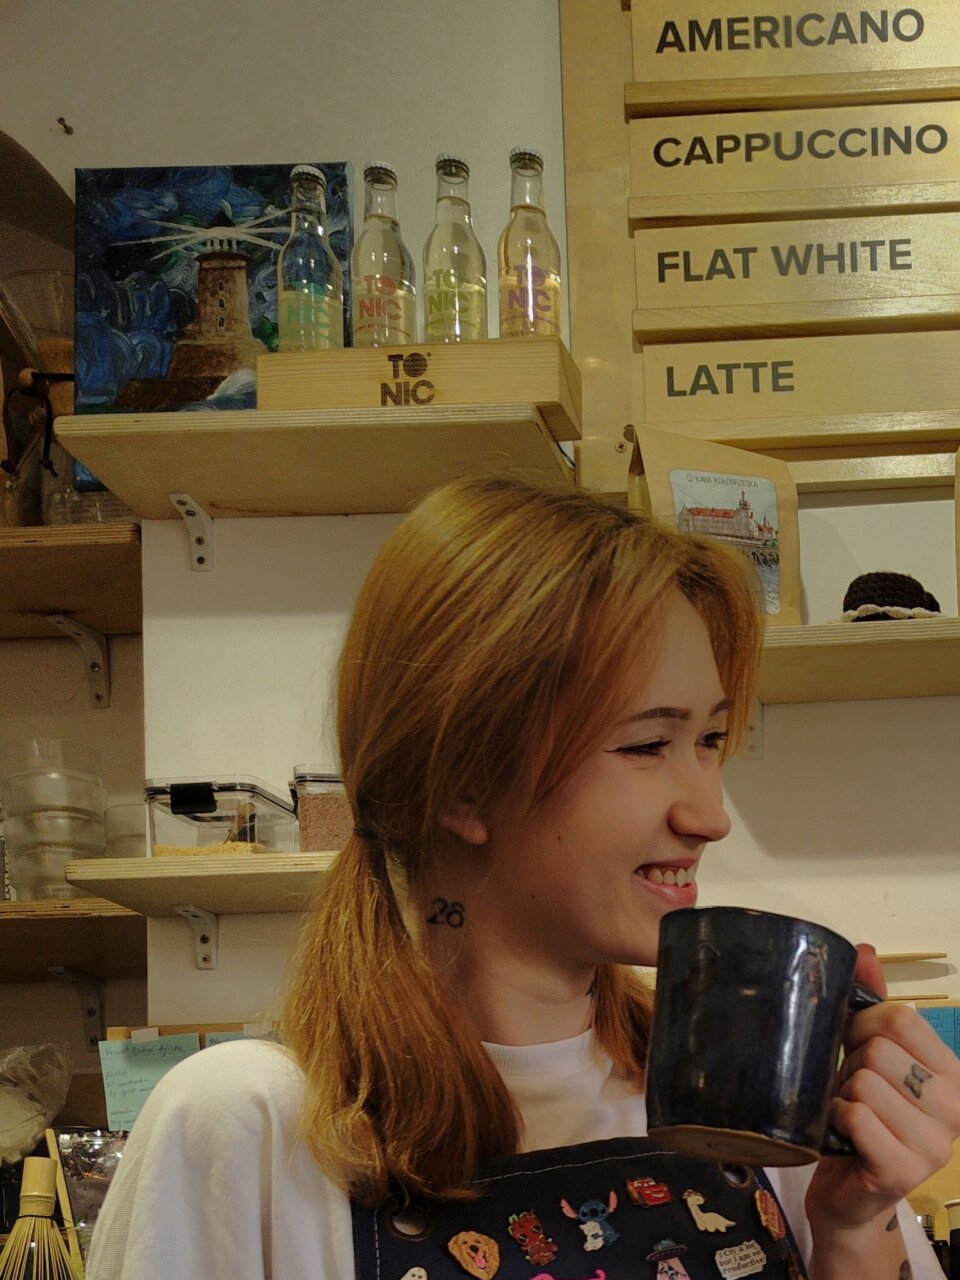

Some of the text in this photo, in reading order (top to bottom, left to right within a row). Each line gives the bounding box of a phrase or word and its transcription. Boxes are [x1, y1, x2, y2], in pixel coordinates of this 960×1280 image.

[655, 8, 924, 54] AMERICANO
[653, 124, 948, 168] CAPPUCCINO
[657, 246, 758, 283] FLAT
[771, 238, 912, 276] WHITE
[381, 380, 435, 406] NIC
[666, 361, 795, 397] LATTE
